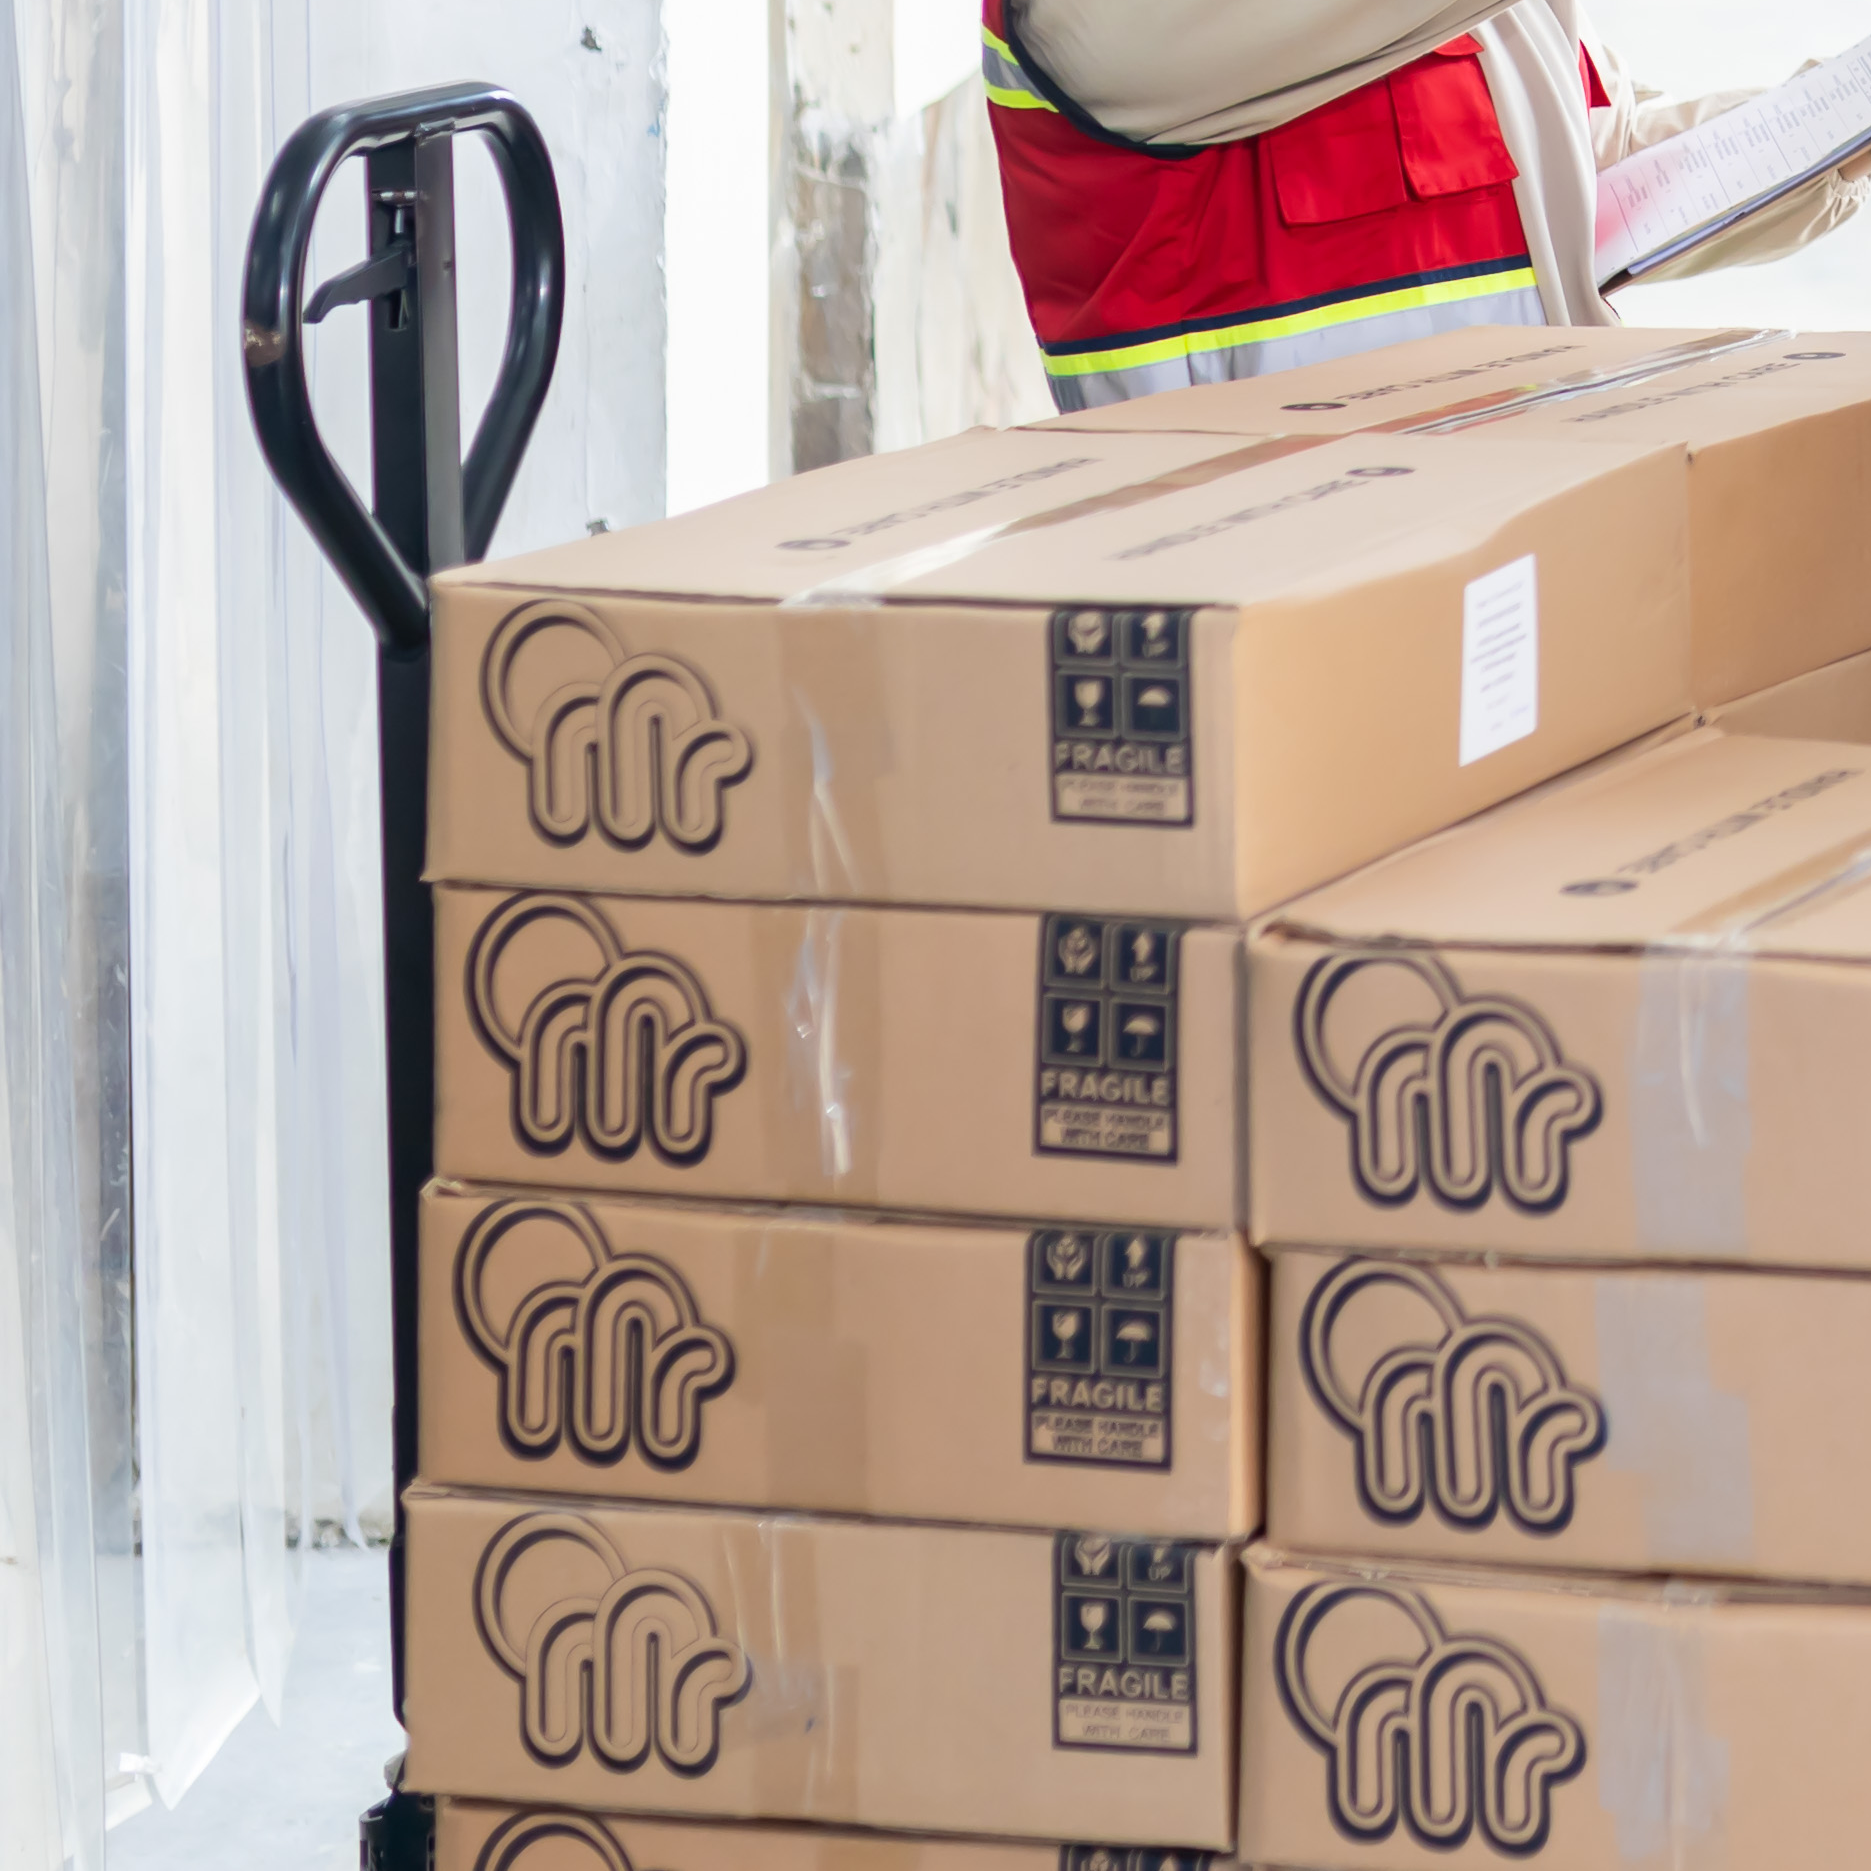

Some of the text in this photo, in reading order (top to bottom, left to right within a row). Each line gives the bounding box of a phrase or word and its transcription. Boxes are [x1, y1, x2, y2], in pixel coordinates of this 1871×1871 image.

[1056, 744, 1183, 774] FRAGILE
[1041, 1070, 1169, 1106] FRAGILE
[1032, 1378, 1161, 1410] FRAGILE
[1059, 1666, 1188, 1700] FRAGILE
[1066, 1704, 1183, 1723] PLEASE HANDLE
[1083, 1725, 1170, 1740] WITH CARE
